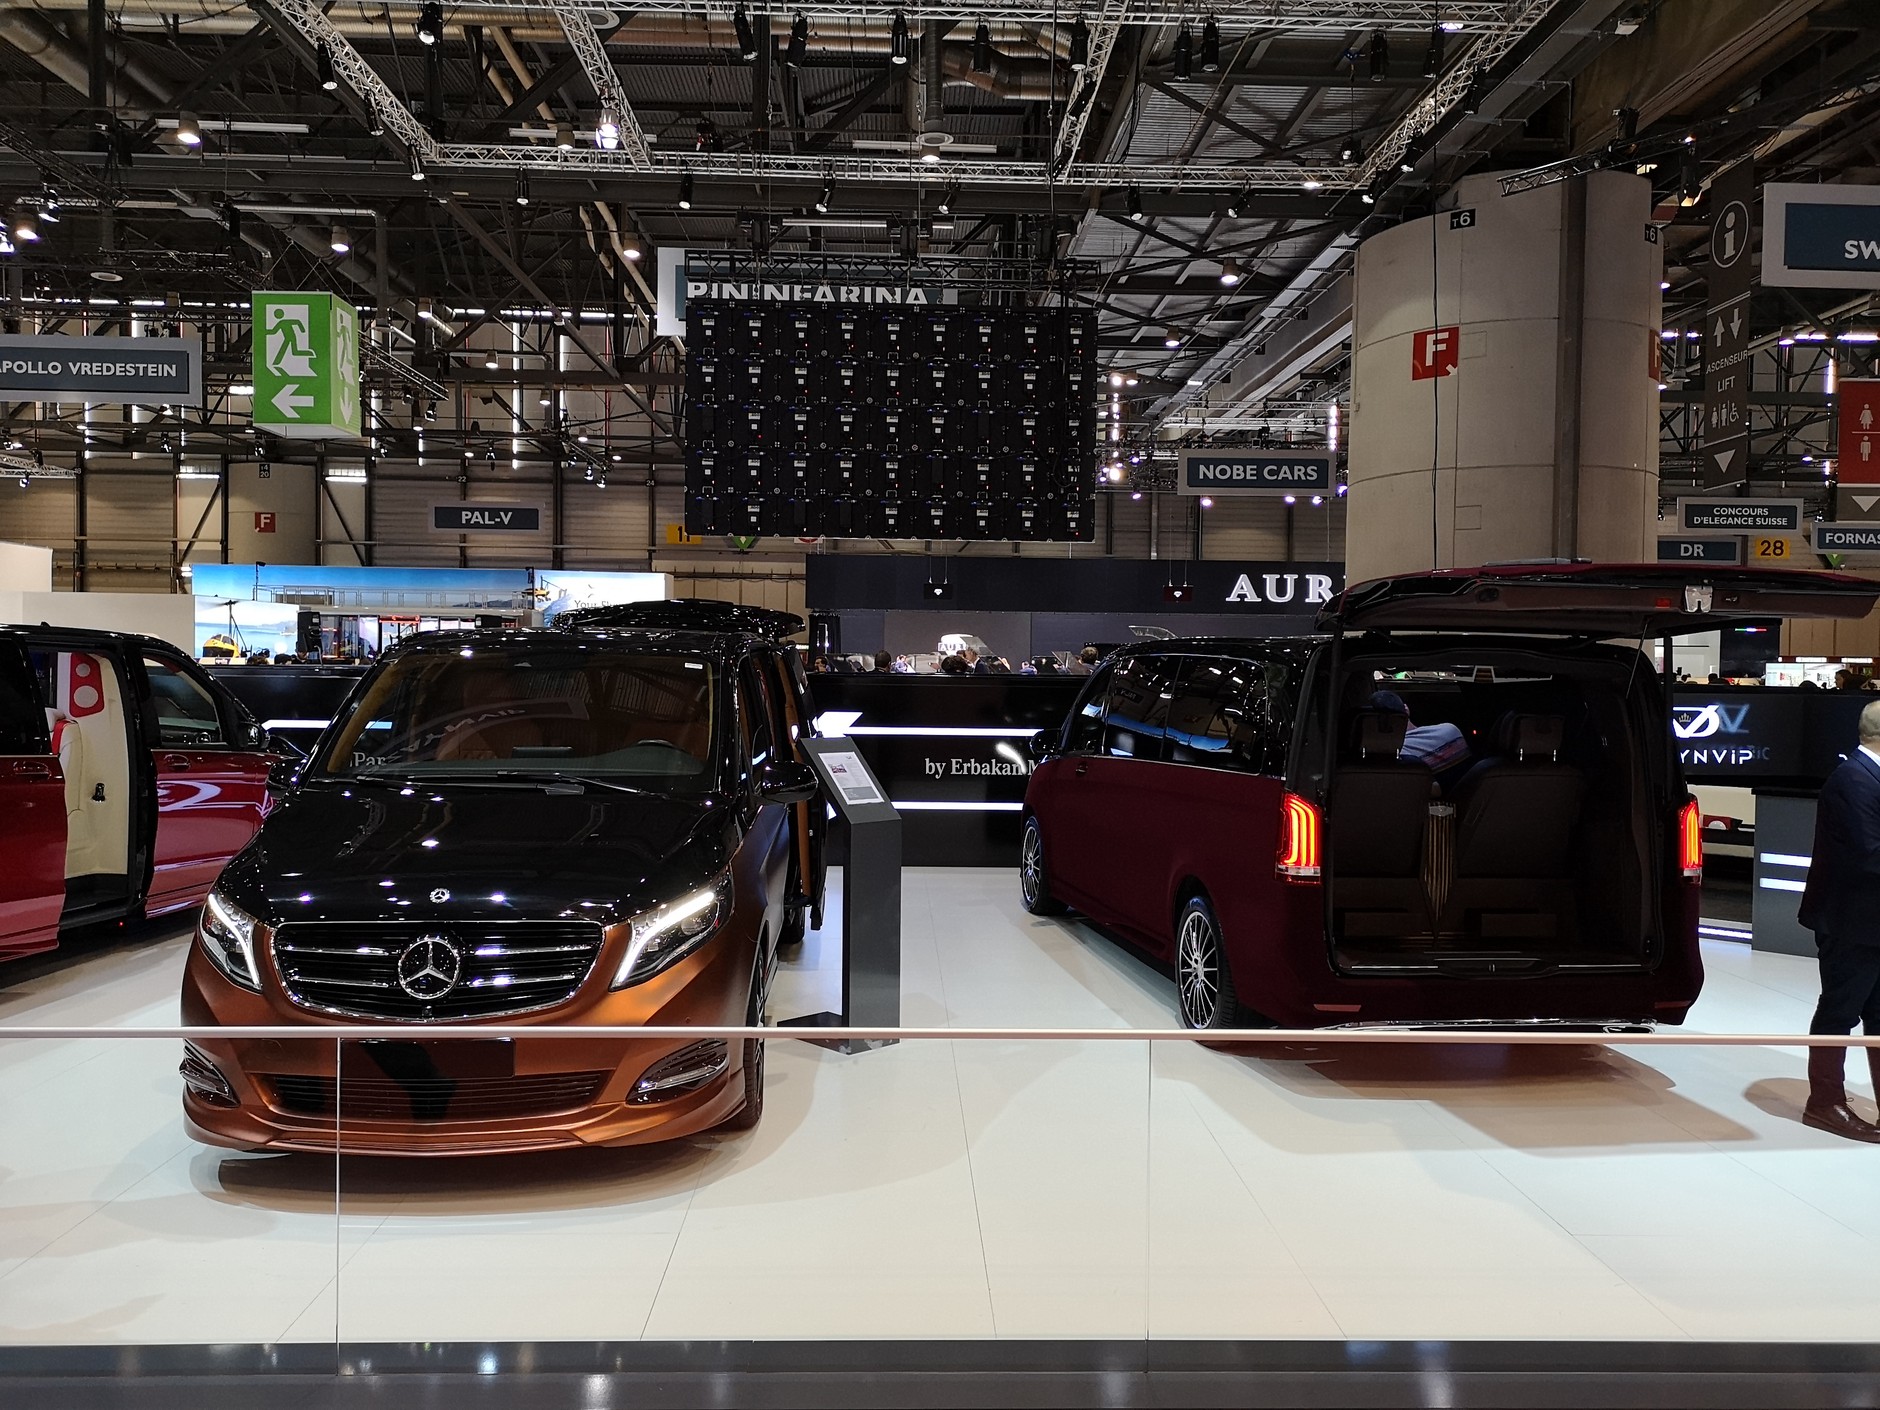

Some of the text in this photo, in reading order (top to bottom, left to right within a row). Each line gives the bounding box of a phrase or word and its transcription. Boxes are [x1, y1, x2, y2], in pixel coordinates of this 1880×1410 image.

[1425, 332, 1449, 367] F
[0, 360, 177, 377] POLLO VREDESTEIN
[1706, 349, 1748, 374] ASCENSEUR
[1717, 376, 1736, 393] LIFT
[1199, 464, 1318, 481] NOBE CARS
[461, 511, 513, 526] PAL-V
[1713, 507, 1769, 516] CONCOURS
[260, 514, 271, 528] F
[1693, 517, 1788, 526] D'ELEGANCE SUISSE
[1680, 544, 1705, 557] DR
[1760, 540, 1785, 556] 28
[1225, 573, 1346, 603] AUR
[925, 758, 946, 779] by
